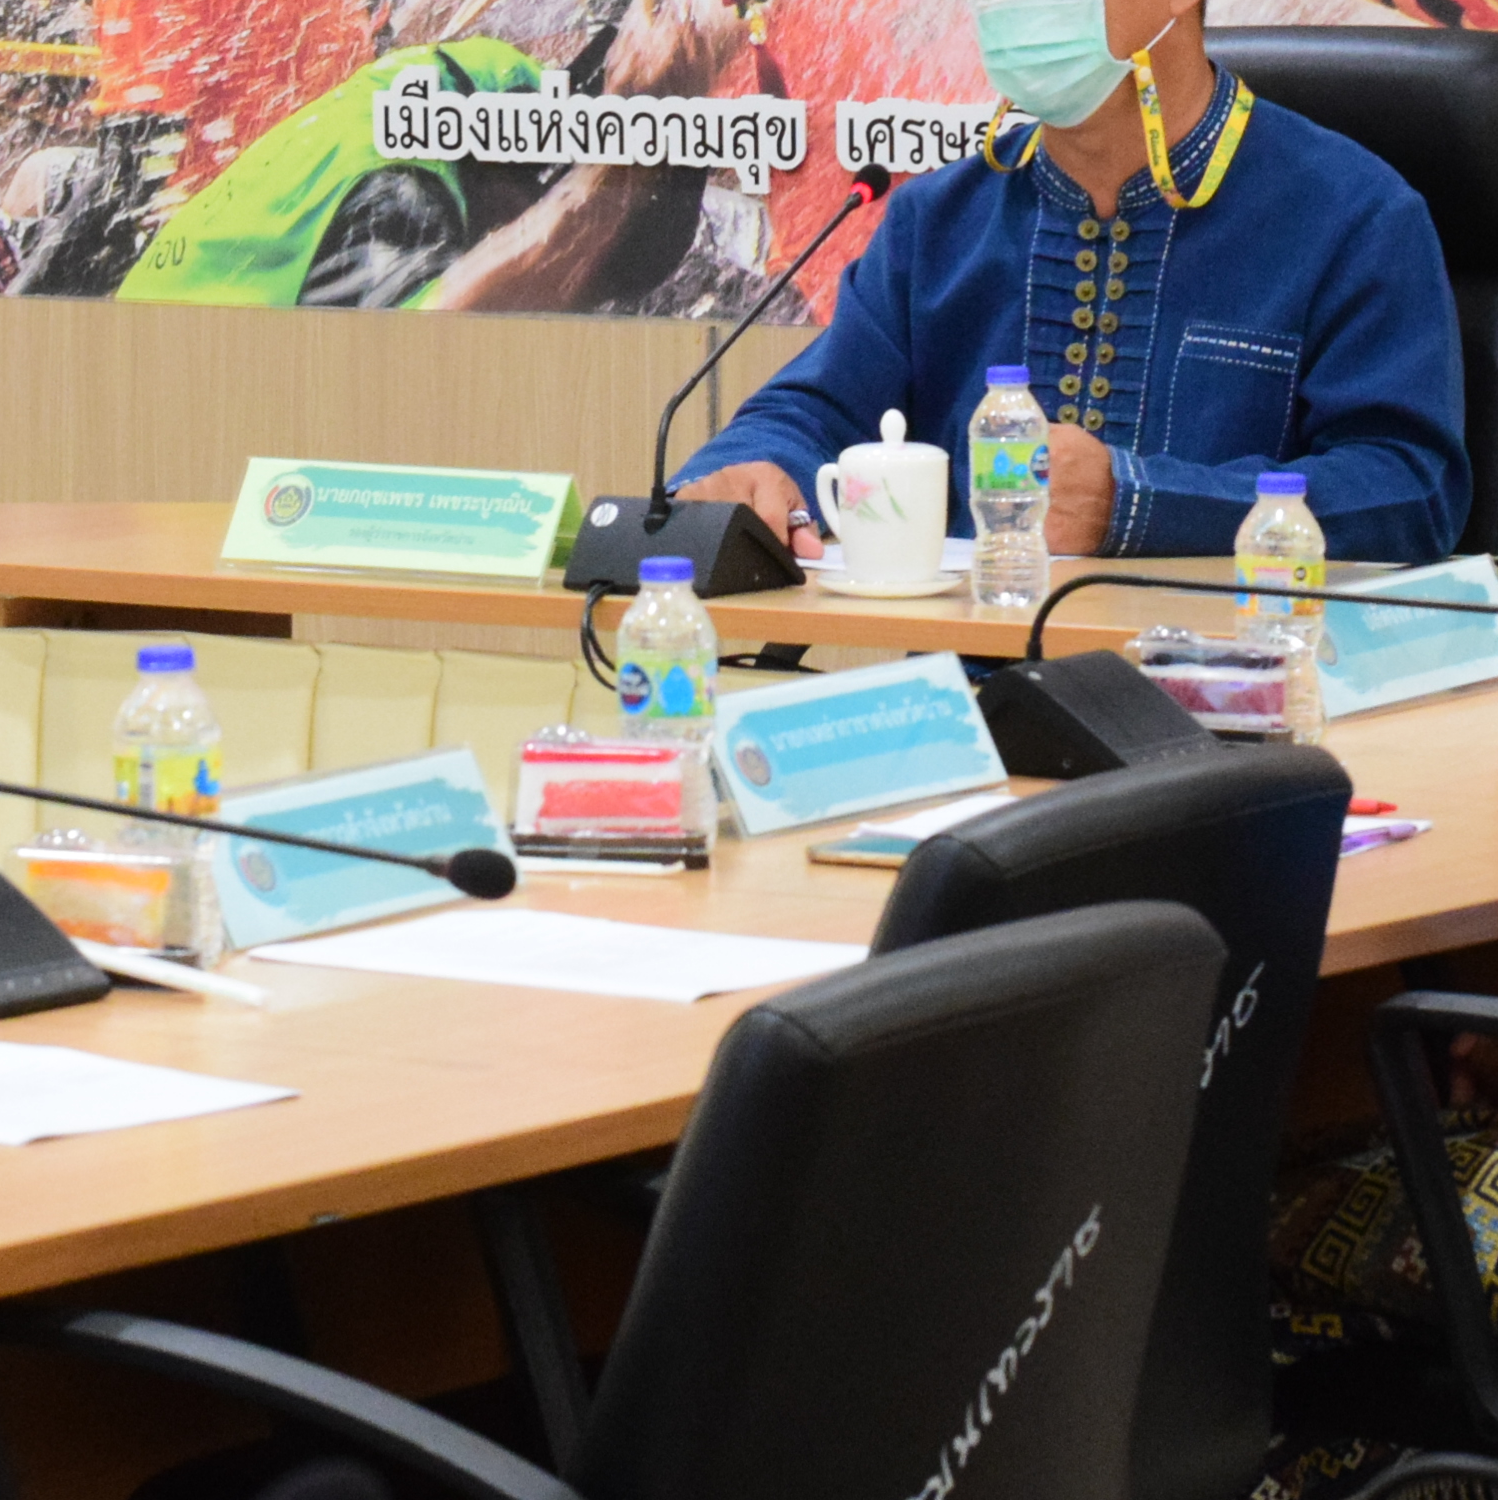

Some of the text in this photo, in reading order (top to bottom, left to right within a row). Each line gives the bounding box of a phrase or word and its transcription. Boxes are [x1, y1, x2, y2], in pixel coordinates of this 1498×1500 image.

[382, 80, 799, 186] เมืองแห่งความสุข
